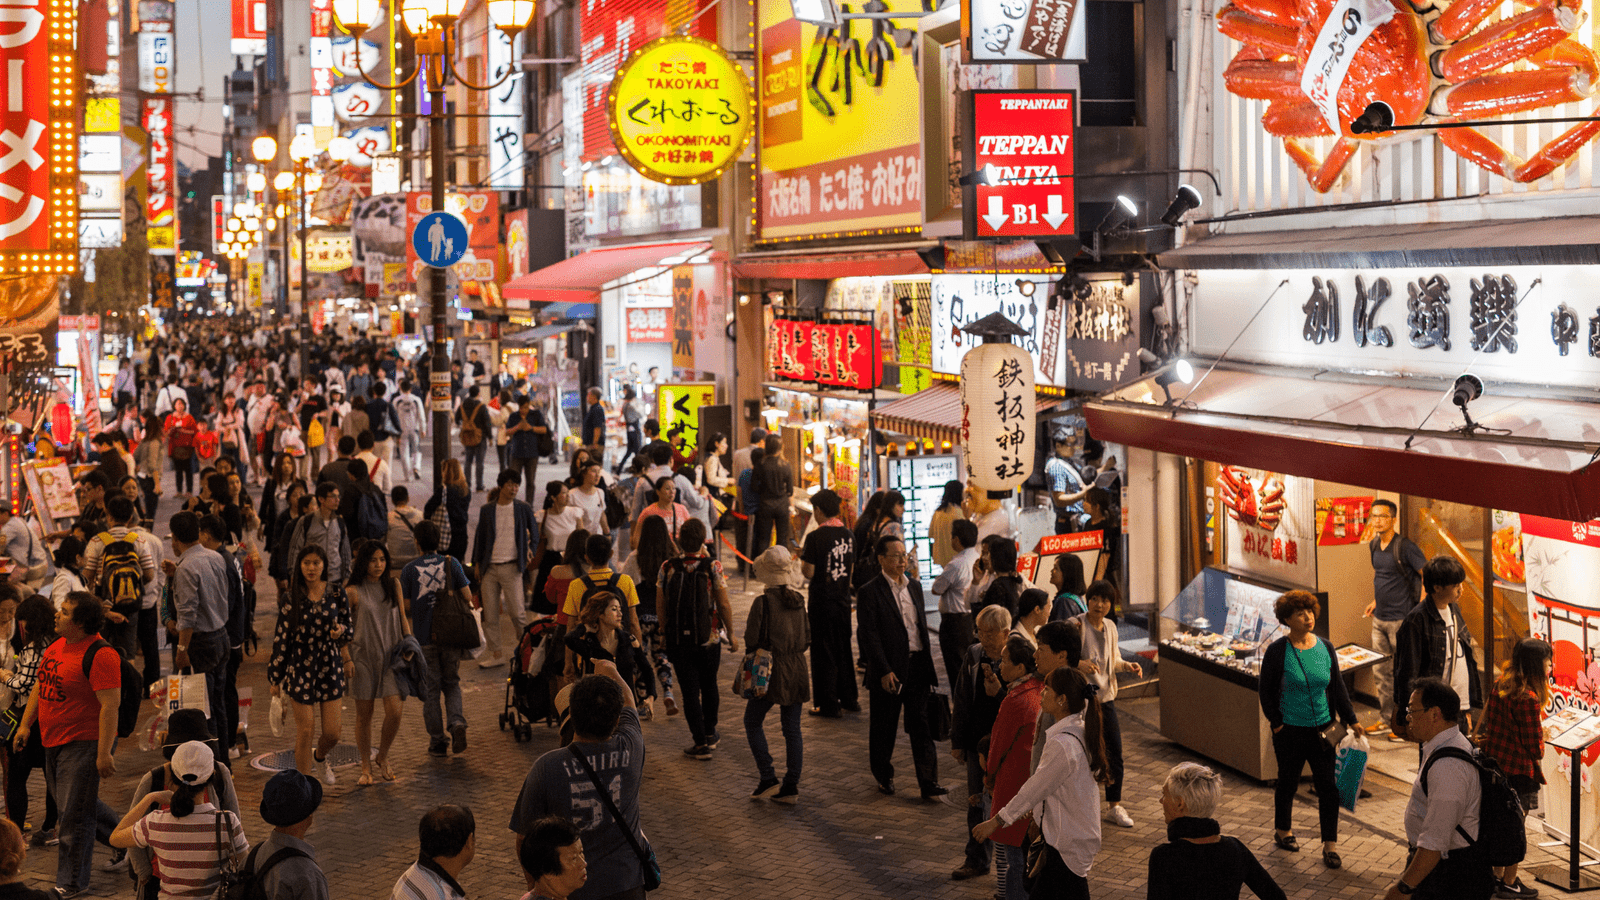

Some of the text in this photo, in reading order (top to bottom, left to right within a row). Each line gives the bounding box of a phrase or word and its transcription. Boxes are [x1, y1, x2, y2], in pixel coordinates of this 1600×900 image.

[647, 78, 719, 90] TAKOYAKI
[628, 98, 740, 126] くれおーる
[1000, 99, 1068, 111] TEPPANYAKI
[637, 135, 730, 146] OKONOMIYAKI
[979, 135, 1069, 155] TEPPAN
[1012, 203, 1039, 224] B1
[993, 358, 1025, 481] 鉄板神社
[1049, 538, 1060, 550] GO
[1062, 537, 1079, 549] down
[831, 538, 849, 581] 神社
[570, 774, 622, 831] 51
